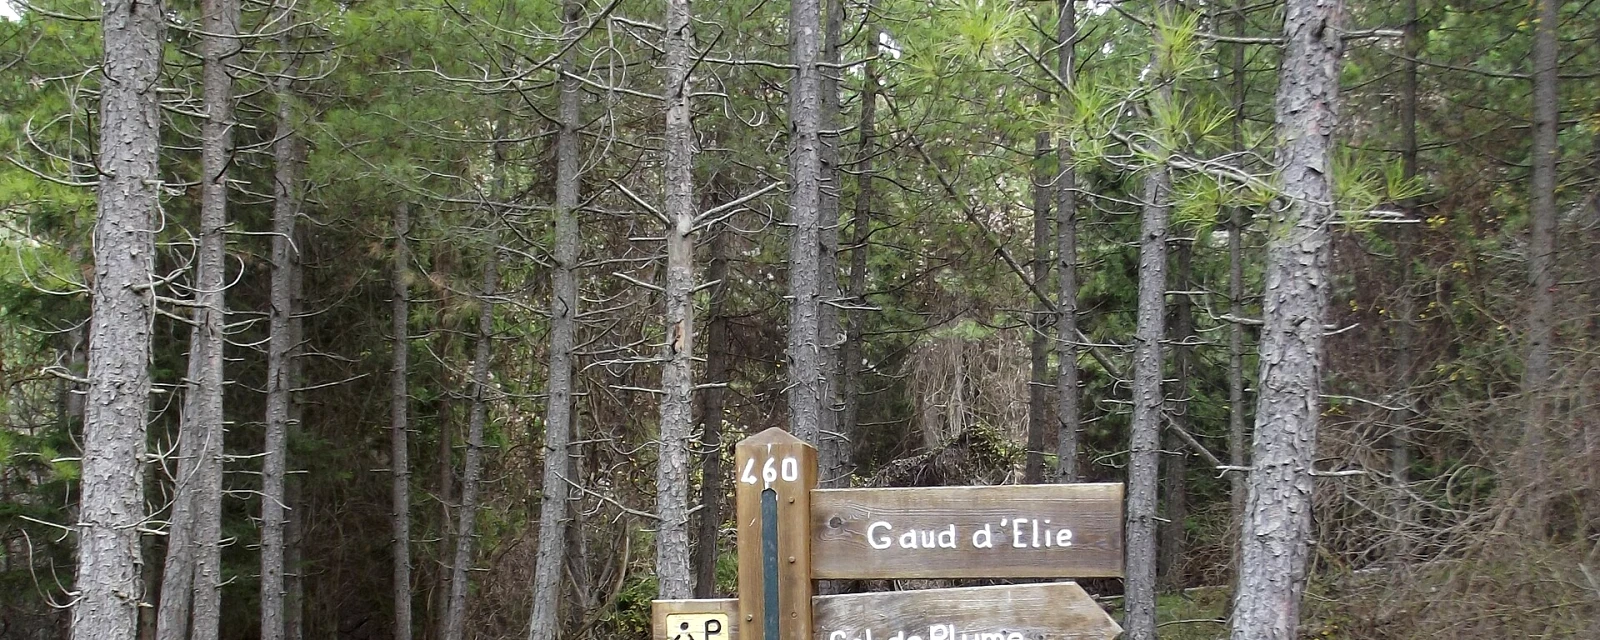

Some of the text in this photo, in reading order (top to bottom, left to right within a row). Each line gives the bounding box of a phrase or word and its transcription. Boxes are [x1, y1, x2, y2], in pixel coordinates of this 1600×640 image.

[740, 457, 799, 485] 460
[866, 517, 1074, 550] Gaud d'Elie
[704, 618, 722, 640] P
